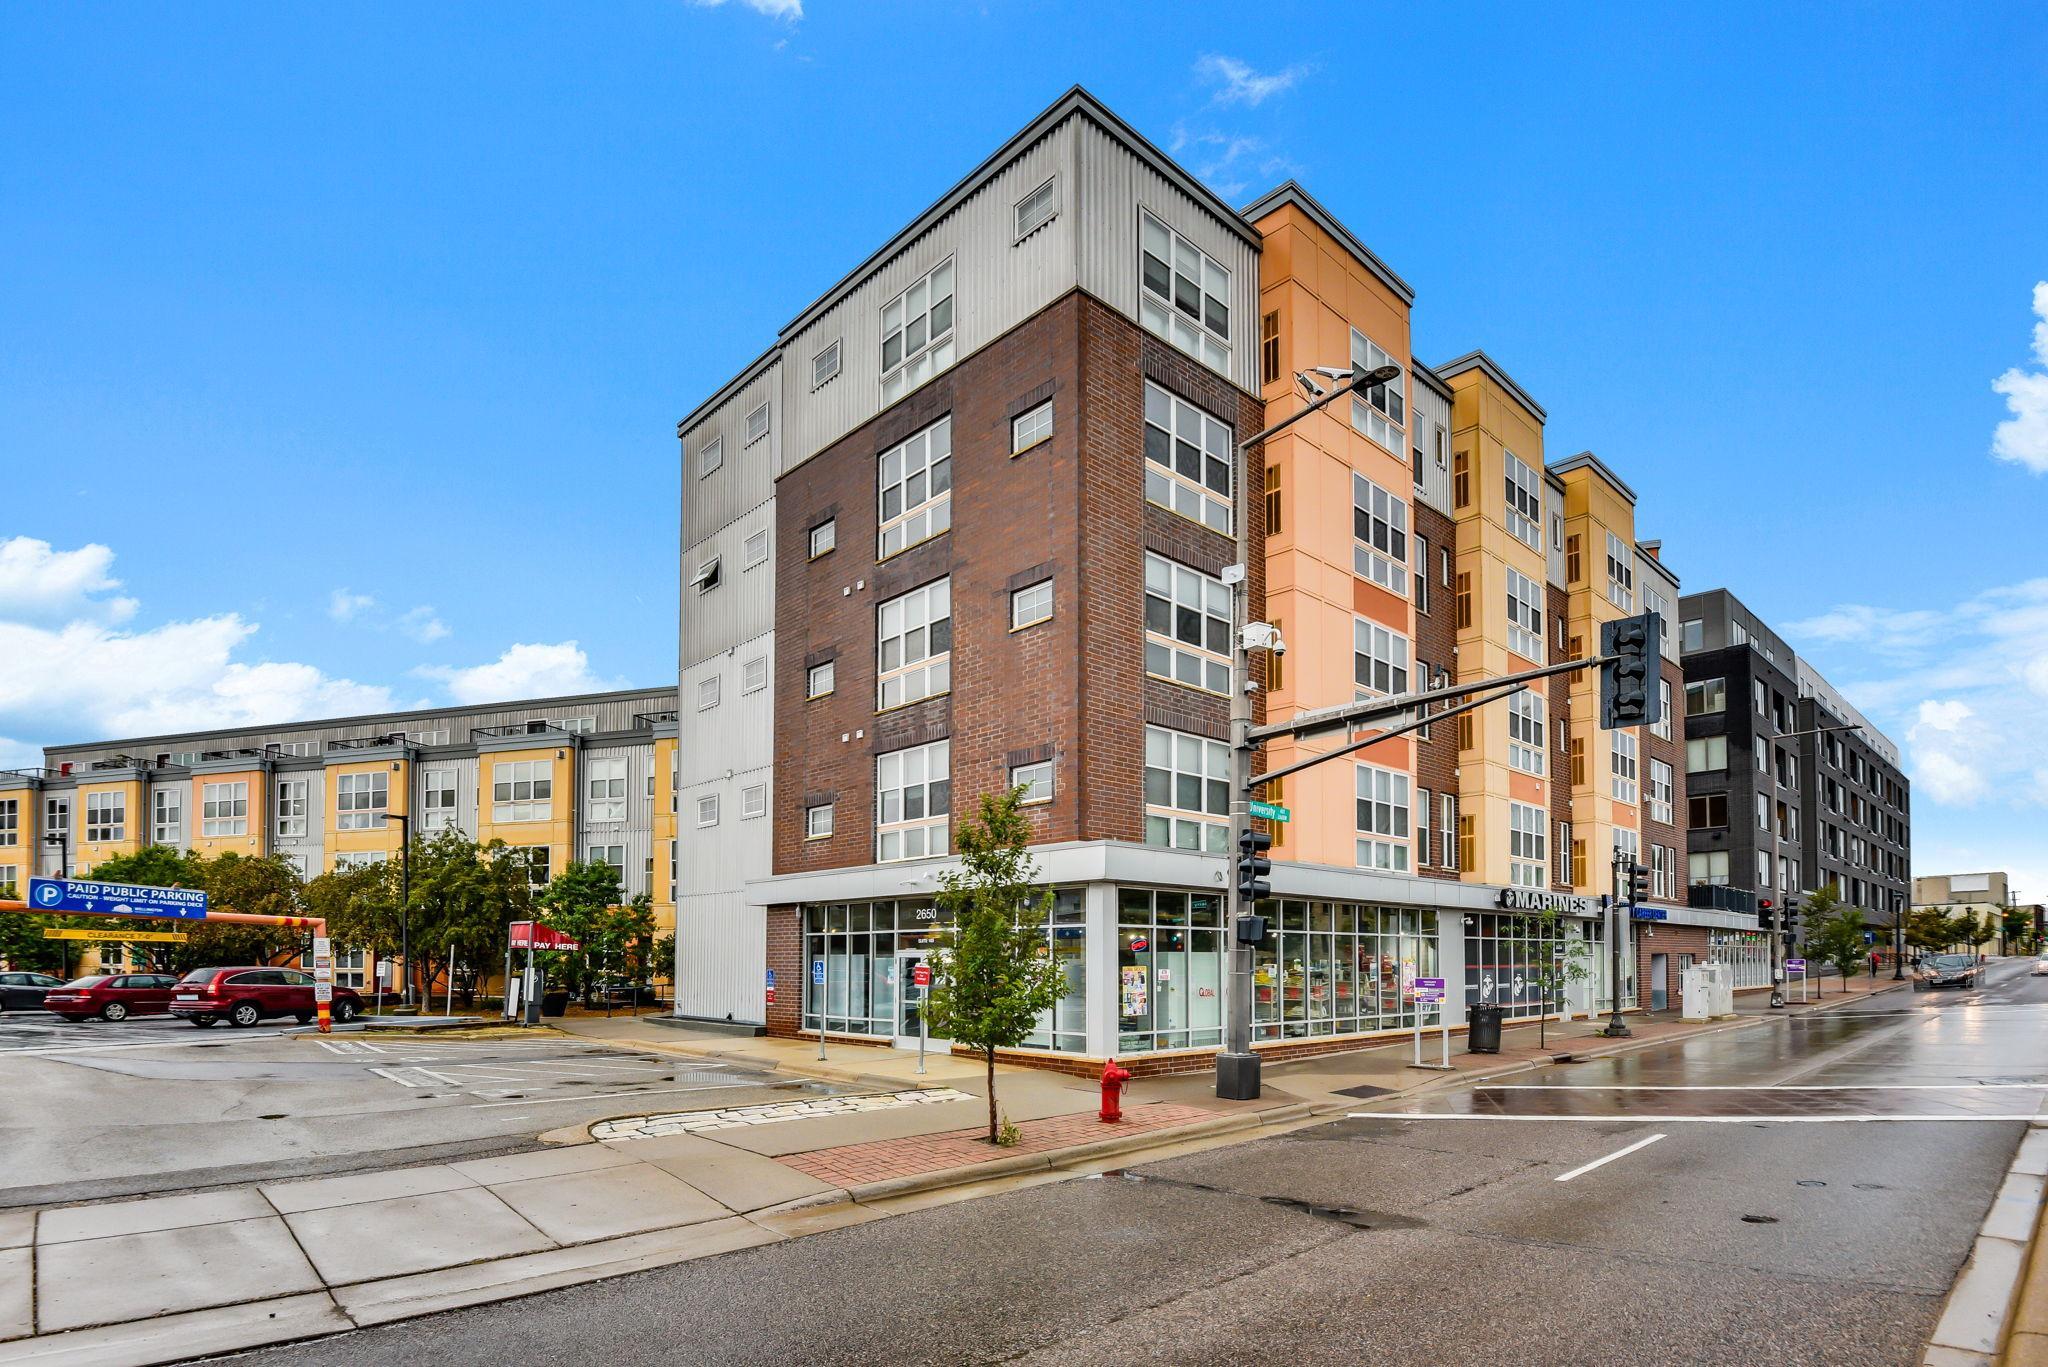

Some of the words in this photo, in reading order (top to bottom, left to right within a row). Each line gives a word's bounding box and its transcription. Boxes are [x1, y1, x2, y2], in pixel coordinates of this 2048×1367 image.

[43, 887, 58, 902] P
[67, 883, 99, 894] PAID
[102, 886, 148, 898] PUBLIC
[151, 890, 204, 902] PARKING
[1514, 891, 1588, 913] MARINES
[916, 908, 937, 920] 2650
[534, 941, 551, 949] PAY
[554, 943, 579, 951] HERE
[1131, 940, 1147, 950] OPEN
